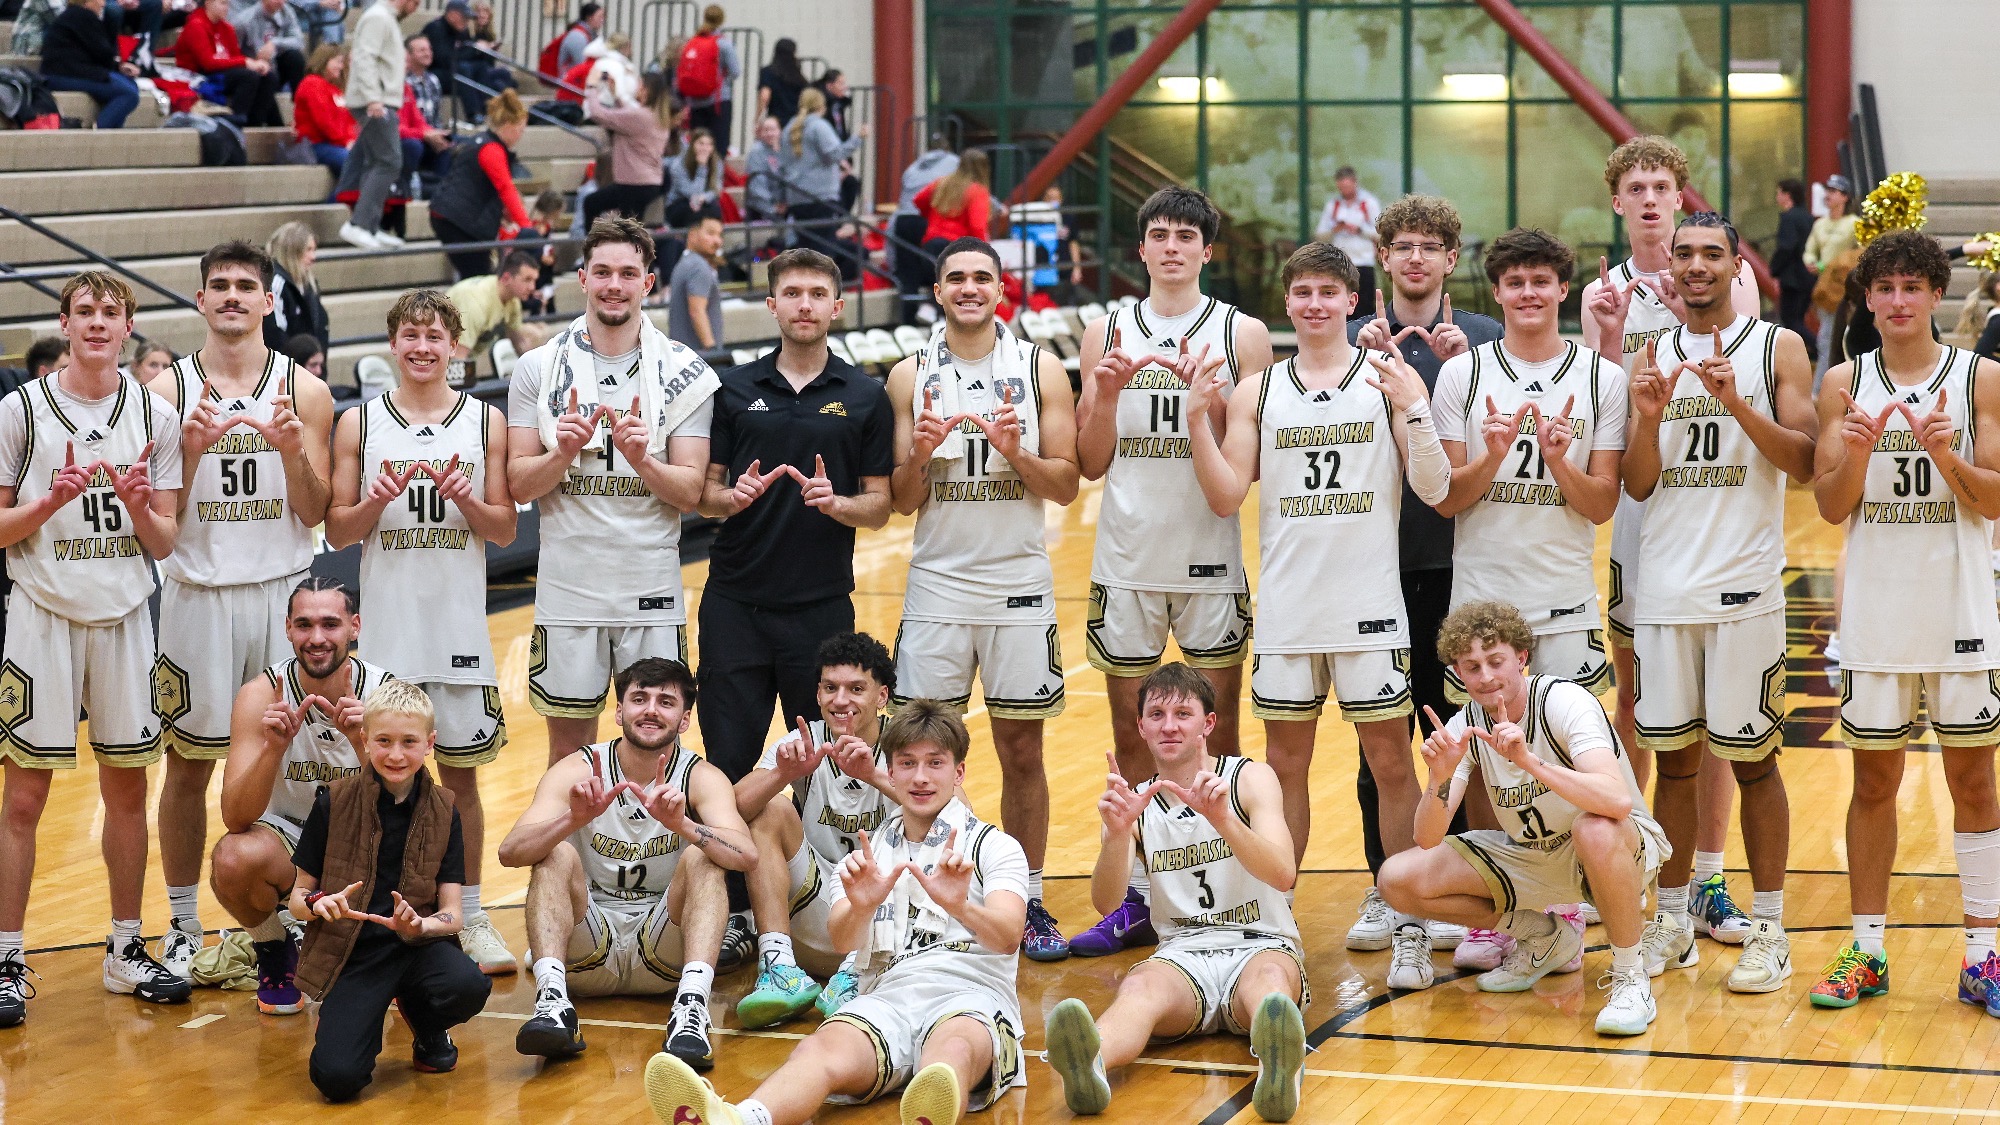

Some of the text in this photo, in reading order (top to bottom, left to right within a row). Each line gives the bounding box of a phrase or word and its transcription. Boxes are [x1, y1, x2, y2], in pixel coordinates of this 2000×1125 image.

[1150, 394, 1180, 433] 14
[1275, 421, 1375, 449] NEBRASKA
[1685, 421, 1720, 462] 20
[220, 458, 257, 497] 50
[1304, 450, 1342, 491] 32
[1661, 466, 1747, 488] WESLEYAN
[1893, 457, 1931, 497] 30
[408, 485, 446, 523] 40
[934, 479, 1025, 502] WESLEYAN
[1279, 491, 1375, 518] WESLEYAN
[82, 491, 122, 533] 45
[197, 499, 284, 522] WESLEYAN
[379, 528, 470, 551] WESLEYAN
[1151, 837, 1234, 874] NEBRASK
[617, 864, 647, 890] 12
[1192, 869, 1215, 910] 3
